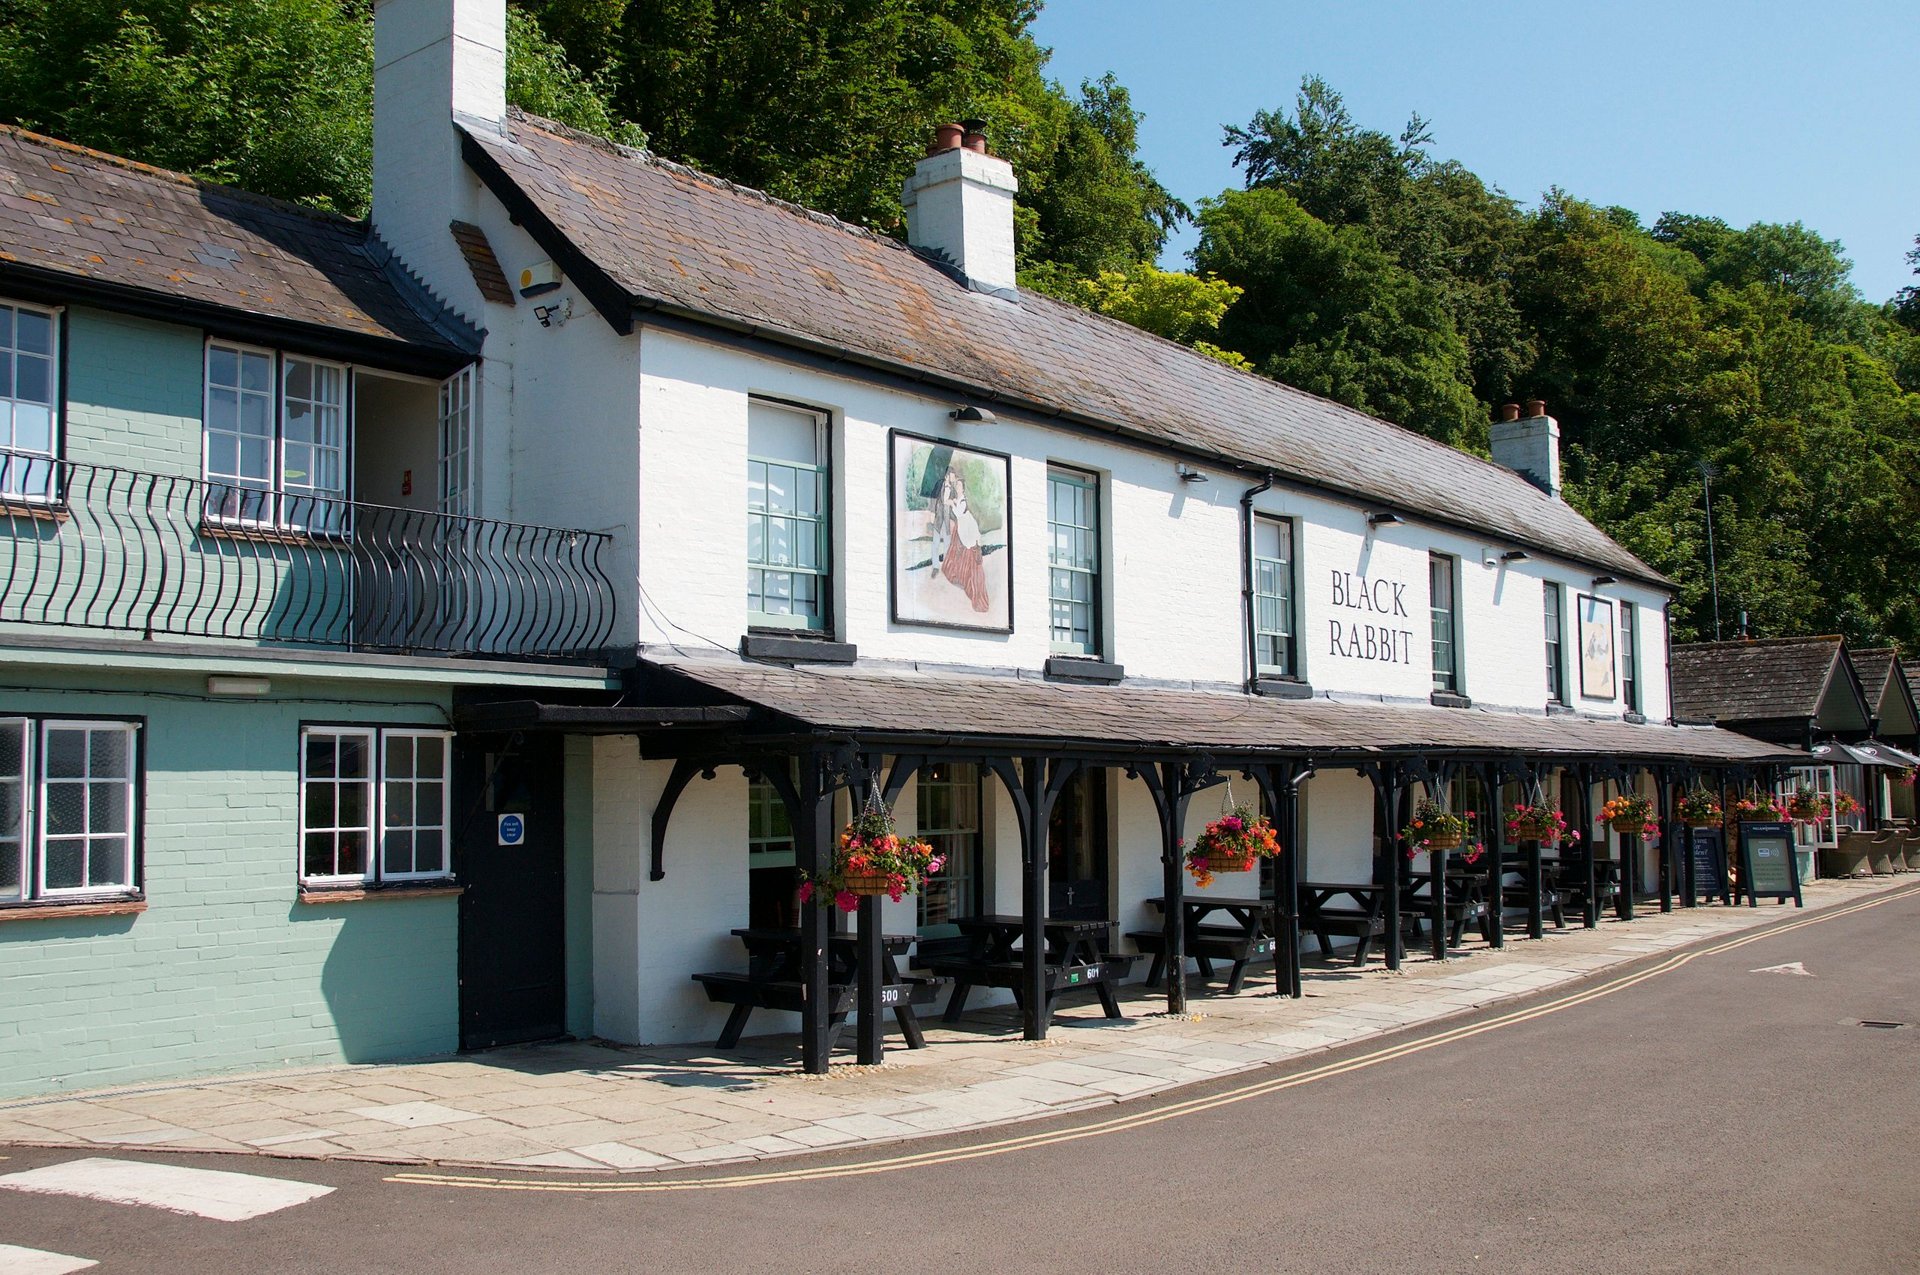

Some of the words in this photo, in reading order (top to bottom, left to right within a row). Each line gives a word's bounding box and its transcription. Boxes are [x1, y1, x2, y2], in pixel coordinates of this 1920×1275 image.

[1331, 569, 1408, 617] BLACK
[1328, 619, 1413, 664] RABBIT
[1087, 967, 1099, 979] 601
